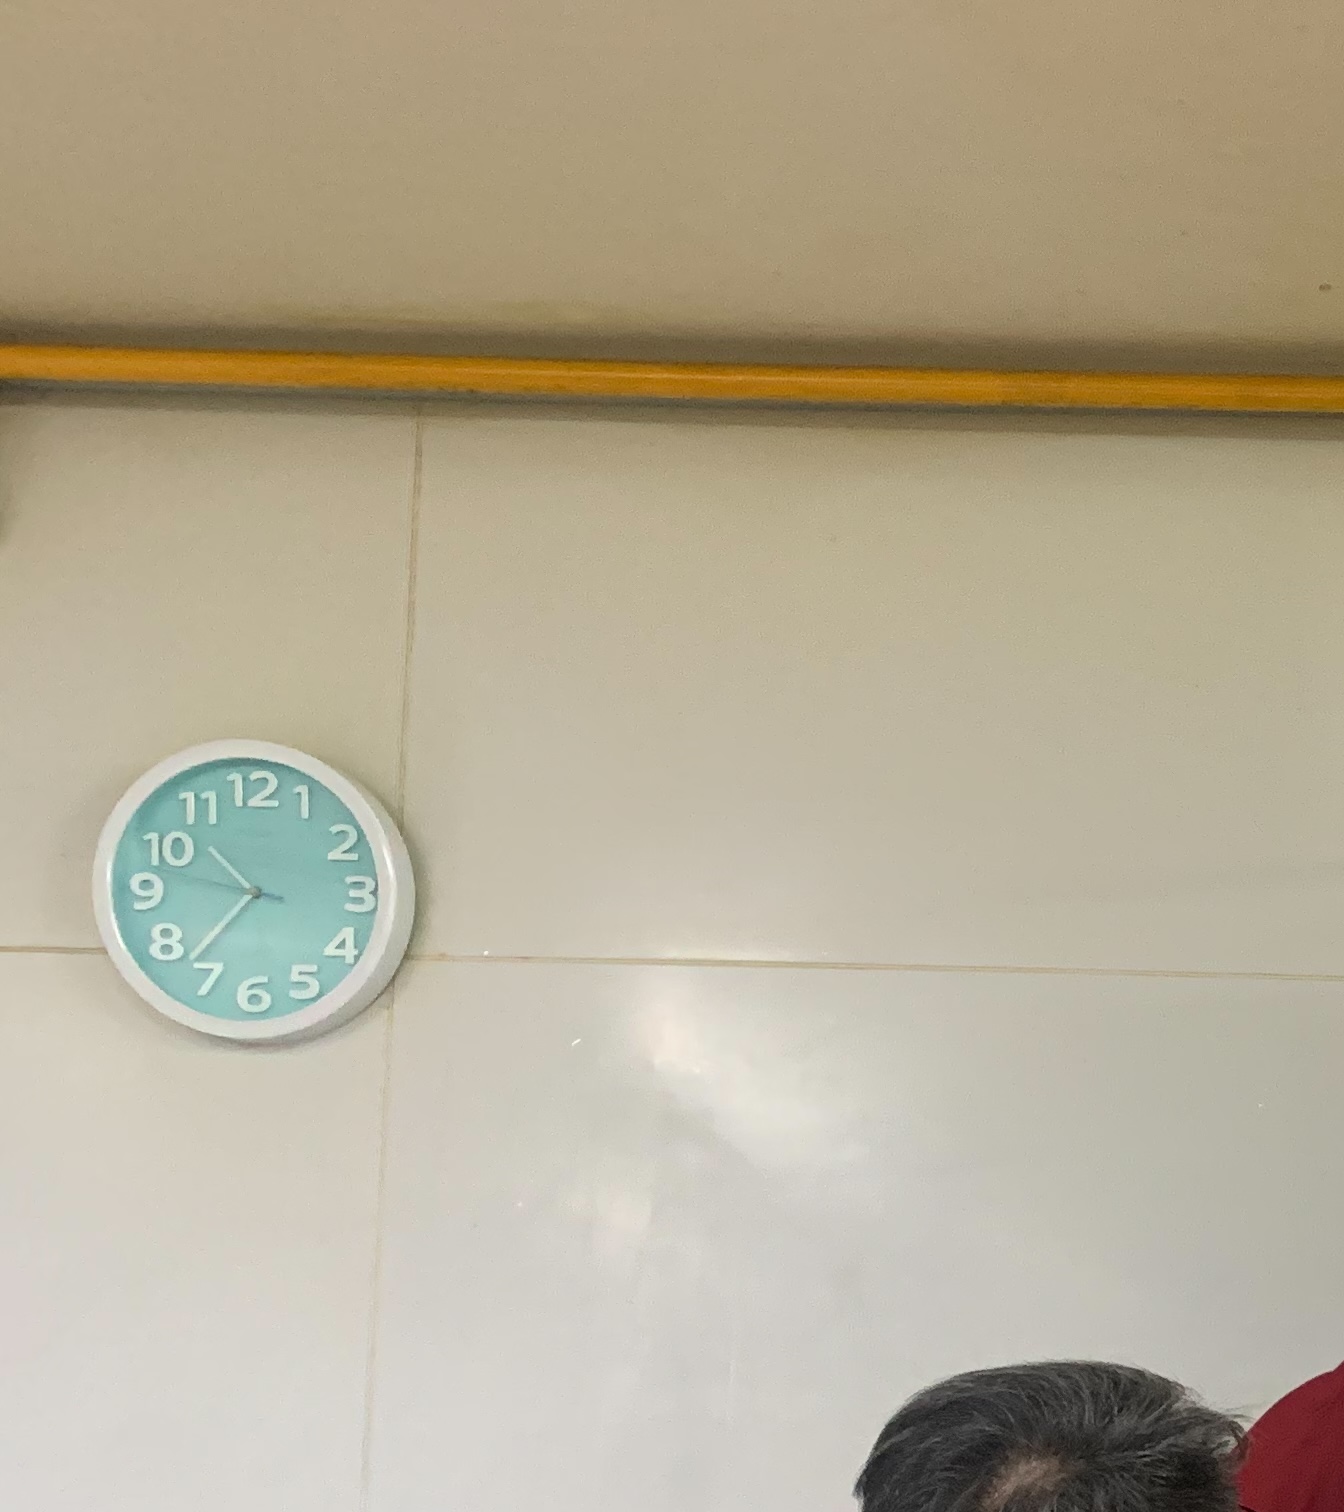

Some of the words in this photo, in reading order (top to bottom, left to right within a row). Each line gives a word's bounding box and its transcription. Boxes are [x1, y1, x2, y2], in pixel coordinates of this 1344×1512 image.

[226, 770, 279, 807] 12
[293, 785, 310, 819] 1
[179, 790, 217, 825] 11
[143, 831, 194, 866] 10
[328, 824, 359, 861] 2
[129, 872, 164, 910] 9
[344, 875, 378, 912] 3
[149, 923, 184, 960] 8
[323, 927, 358, 964] 4
[193, 962, 224, 996] 7
[236, 976, 272, 1013] 6
[289, 964, 320, 1000] 5
